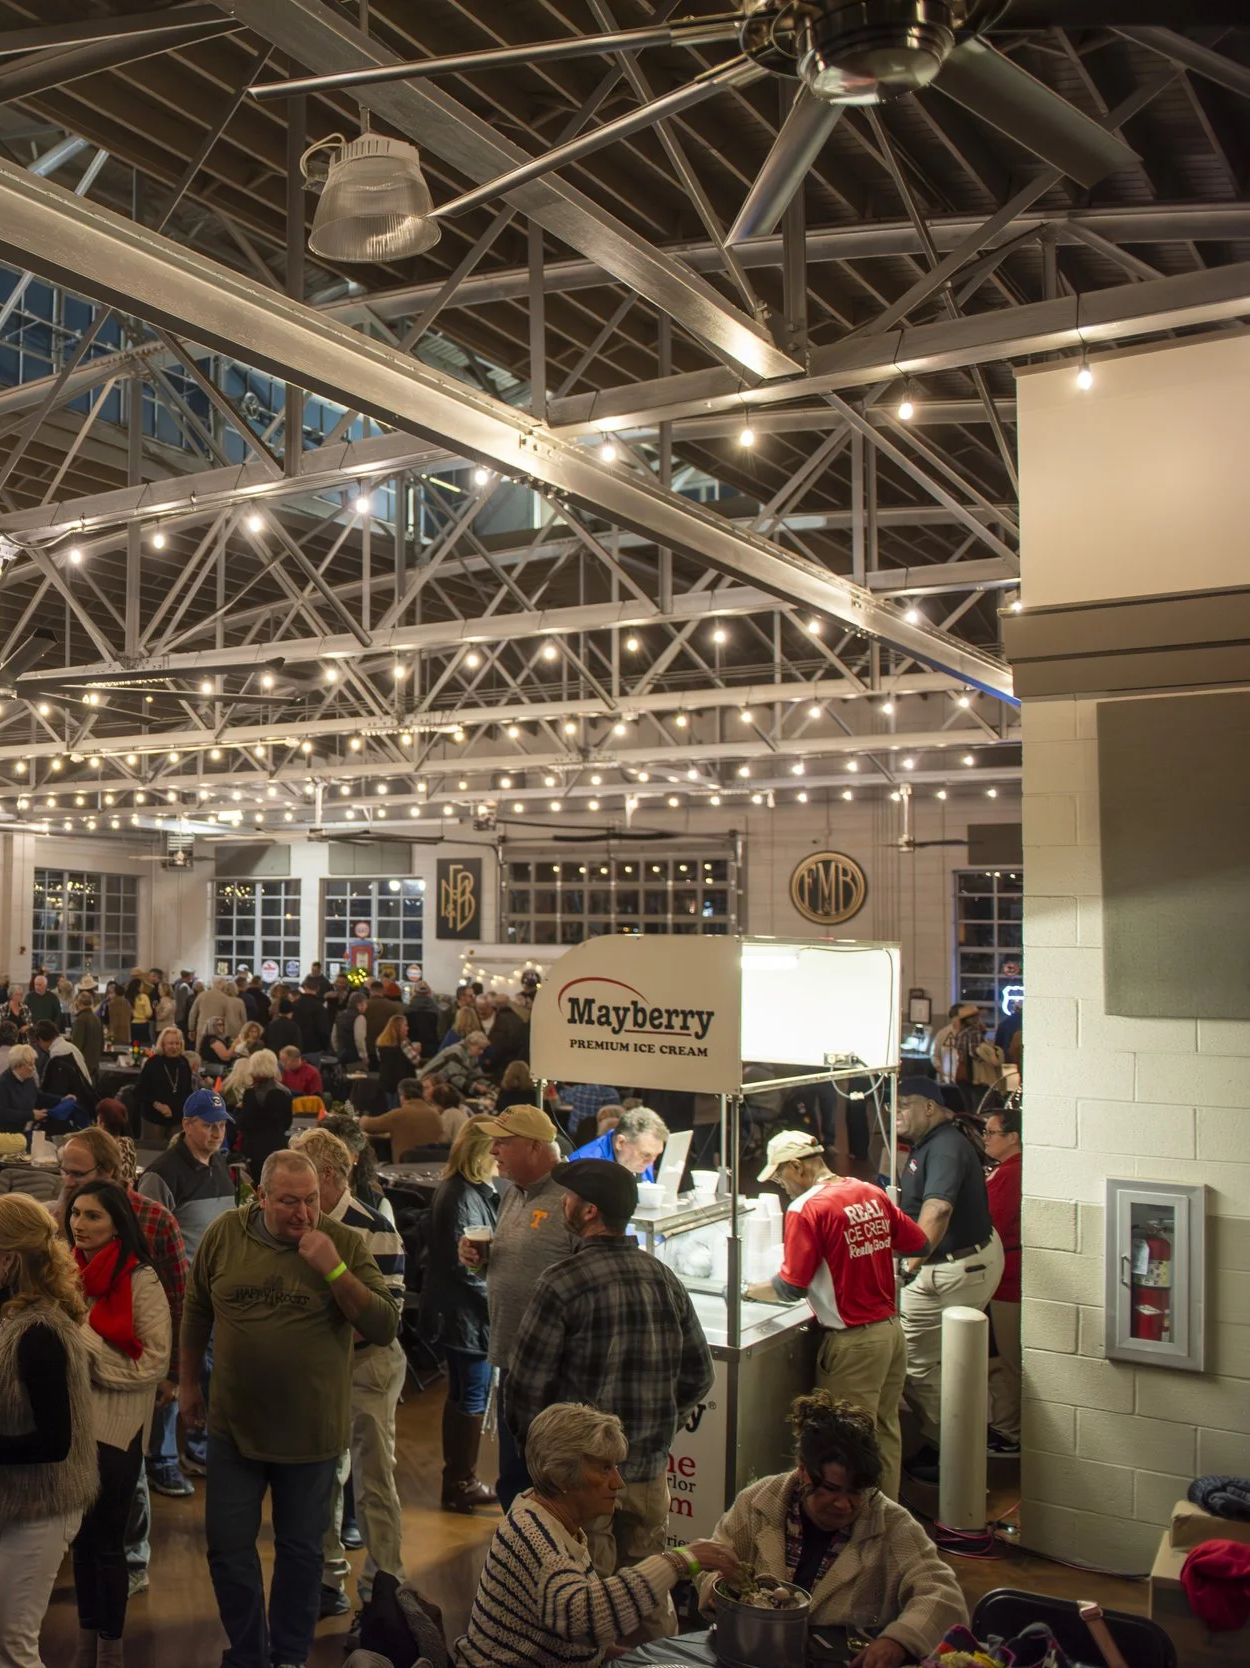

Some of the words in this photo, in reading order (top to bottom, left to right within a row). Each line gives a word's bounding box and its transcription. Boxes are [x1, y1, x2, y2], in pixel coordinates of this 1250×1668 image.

[567, 997, 715, 1040] Mayberry
[569, 1038, 630, 1052] PREMIUM
[633, 1043, 656, 1054] ICE
[659, 1044, 709, 1057] CREAM
[530, 1209, 550, 1229] T
[843, 1199, 884, 1225] REAL
[843, 1226, 865, 1245] ICE
